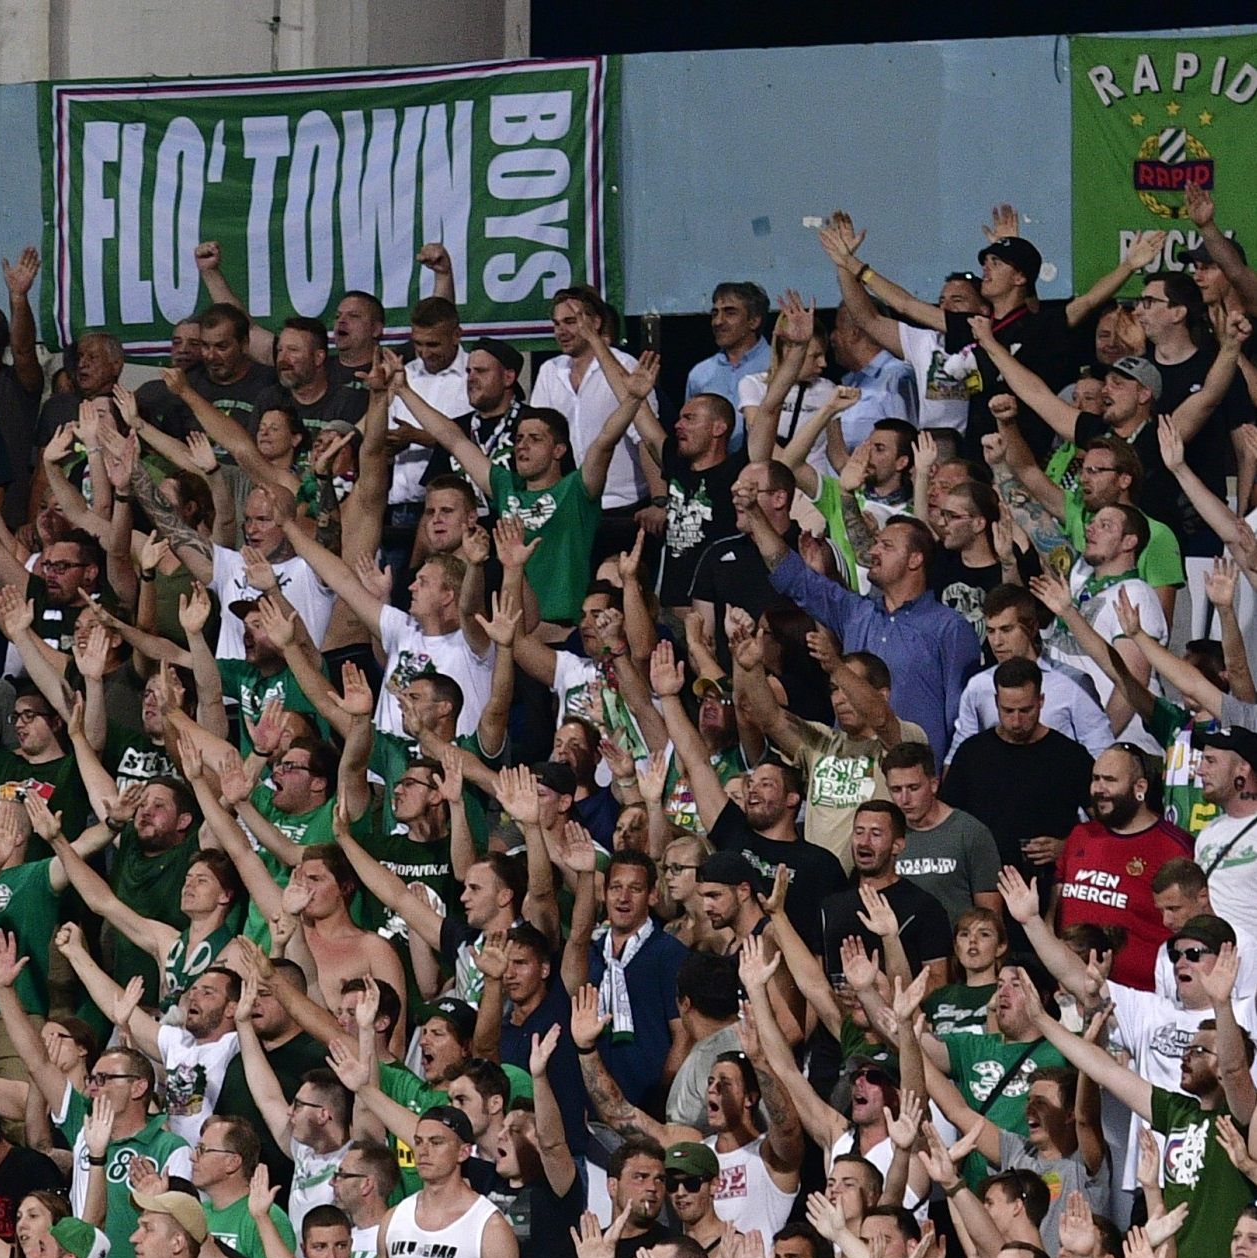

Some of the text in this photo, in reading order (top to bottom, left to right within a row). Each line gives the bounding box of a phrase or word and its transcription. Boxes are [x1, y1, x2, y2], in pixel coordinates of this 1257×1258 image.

[1087, 52, 1257, 107] RAPID
[1138, 163, 1211, 190] RAPID
[482, 89, 573, 303] BOYS
[1075, 869, 1121, 889] WIEN
[1062, 884, 1129, 910] ENERGIE
